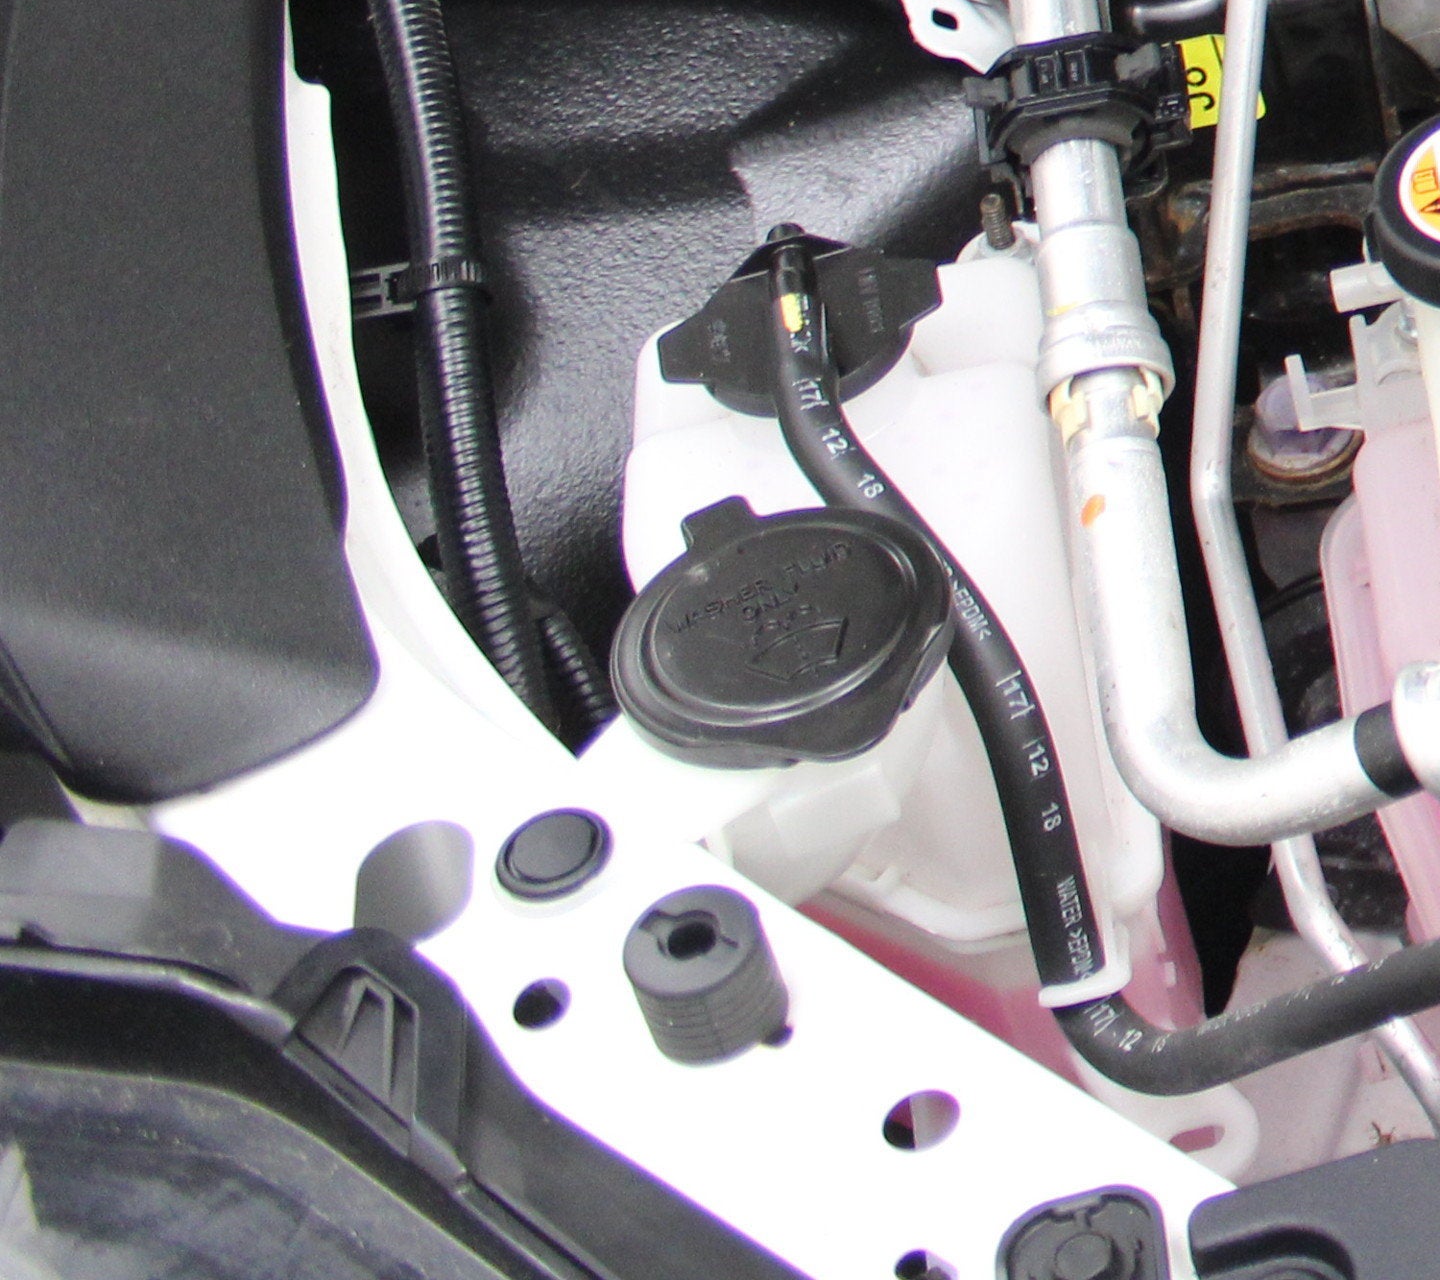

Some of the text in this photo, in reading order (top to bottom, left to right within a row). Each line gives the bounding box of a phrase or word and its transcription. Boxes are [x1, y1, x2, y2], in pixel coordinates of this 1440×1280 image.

[822, 428, 848, 455] 12
[858, 473, 885, 499] 18
[1027, 742, 1050, 777] 12
[1041, 802, 1062, 832] 18
[1056, 875, 1083, 928] WATER
[1118, 1028, 1143, 1052] 12
